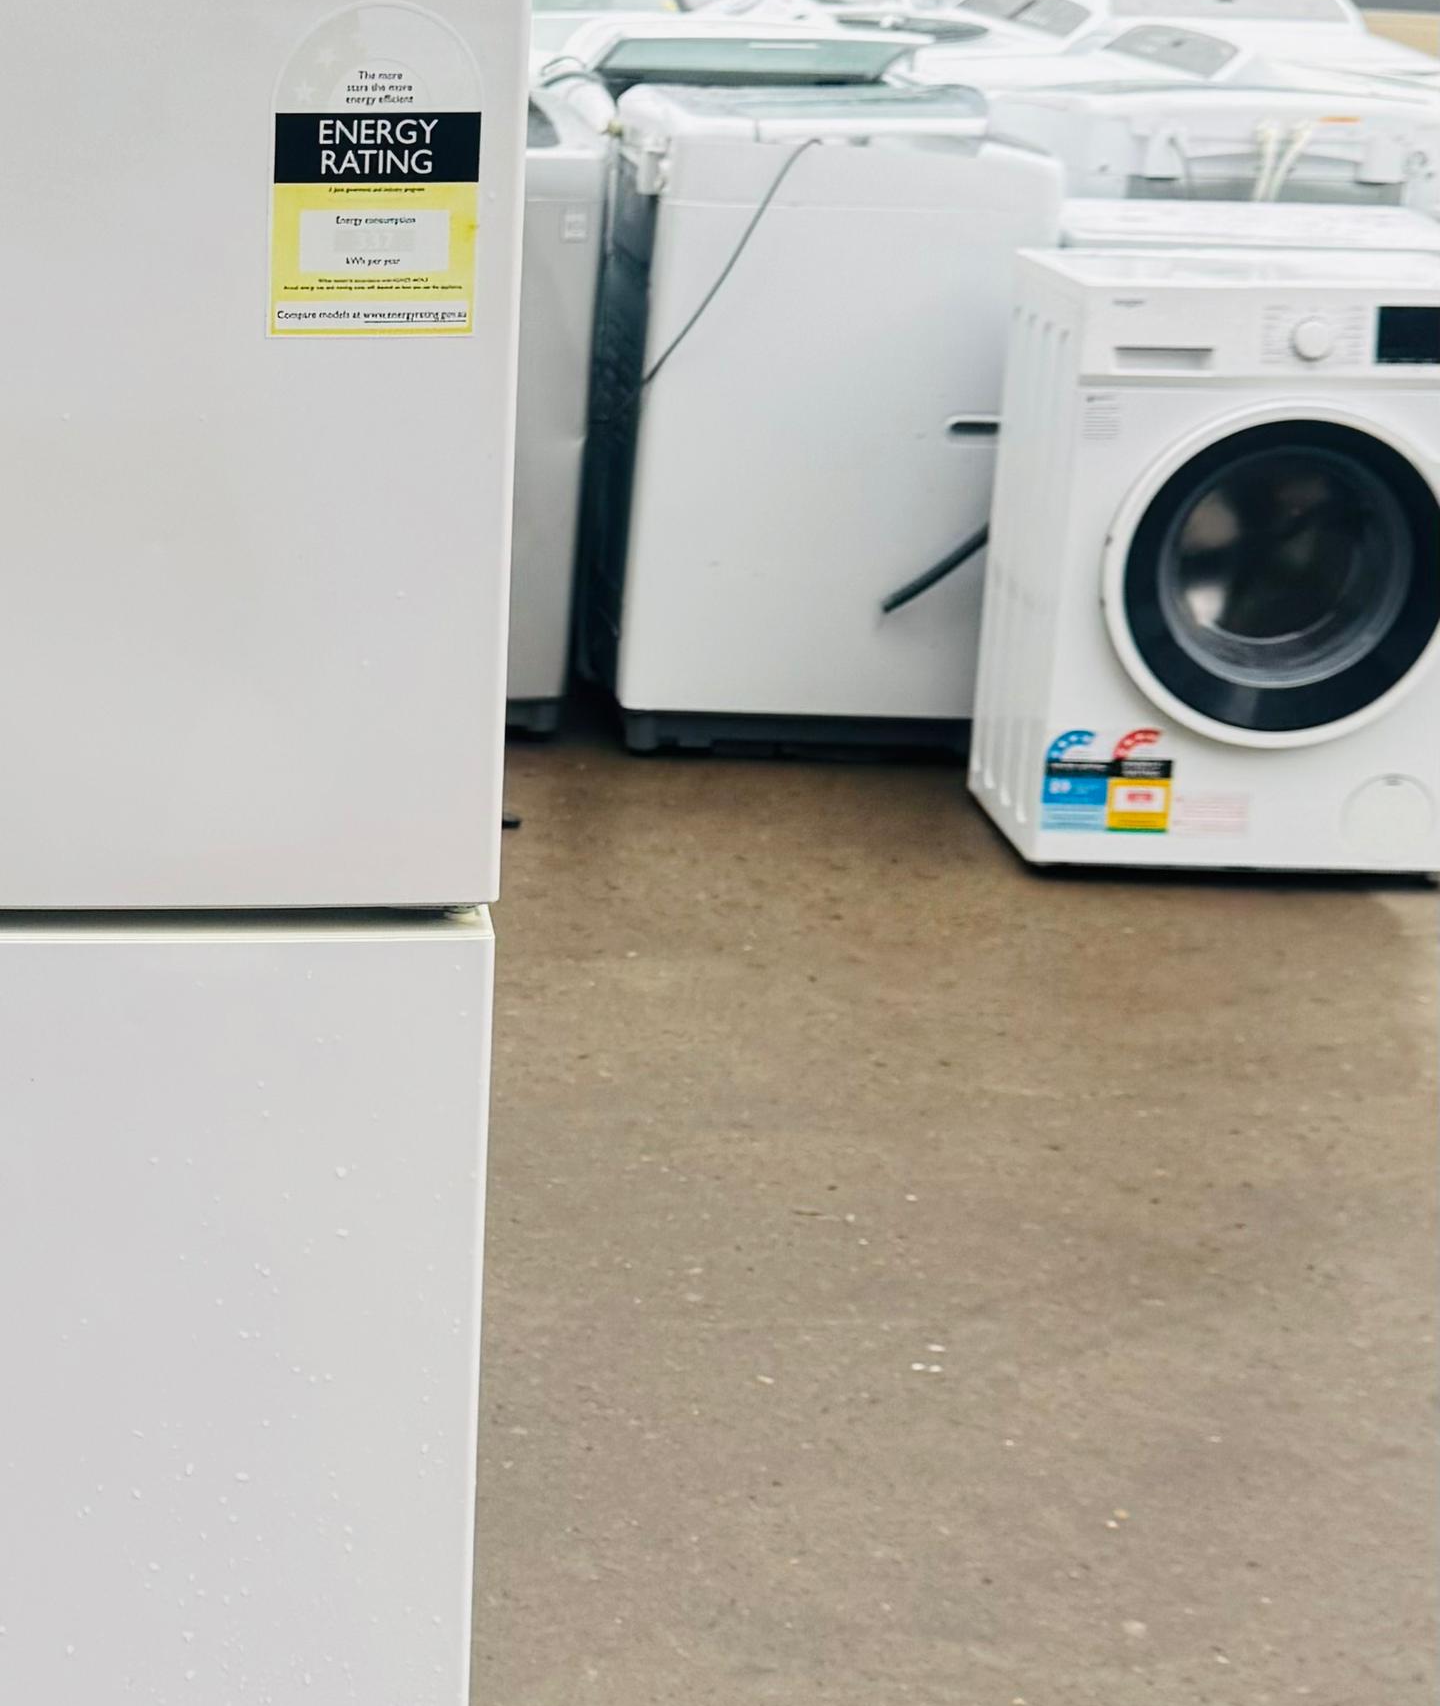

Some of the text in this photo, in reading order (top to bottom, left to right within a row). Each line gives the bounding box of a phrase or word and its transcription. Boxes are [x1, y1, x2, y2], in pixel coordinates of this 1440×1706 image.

[358, 70, 403, 80] The more
[371, 82, 386, 92] the
[345, 94, 414, 106] energy efficient
[318, 119, 439, 145] ENERGY
[320, 149, 433, 175] RATING
[335, 215, 362, 226] Energy
[276, 309, 317, 320] Compare
[318, 310, 351, 319] models
